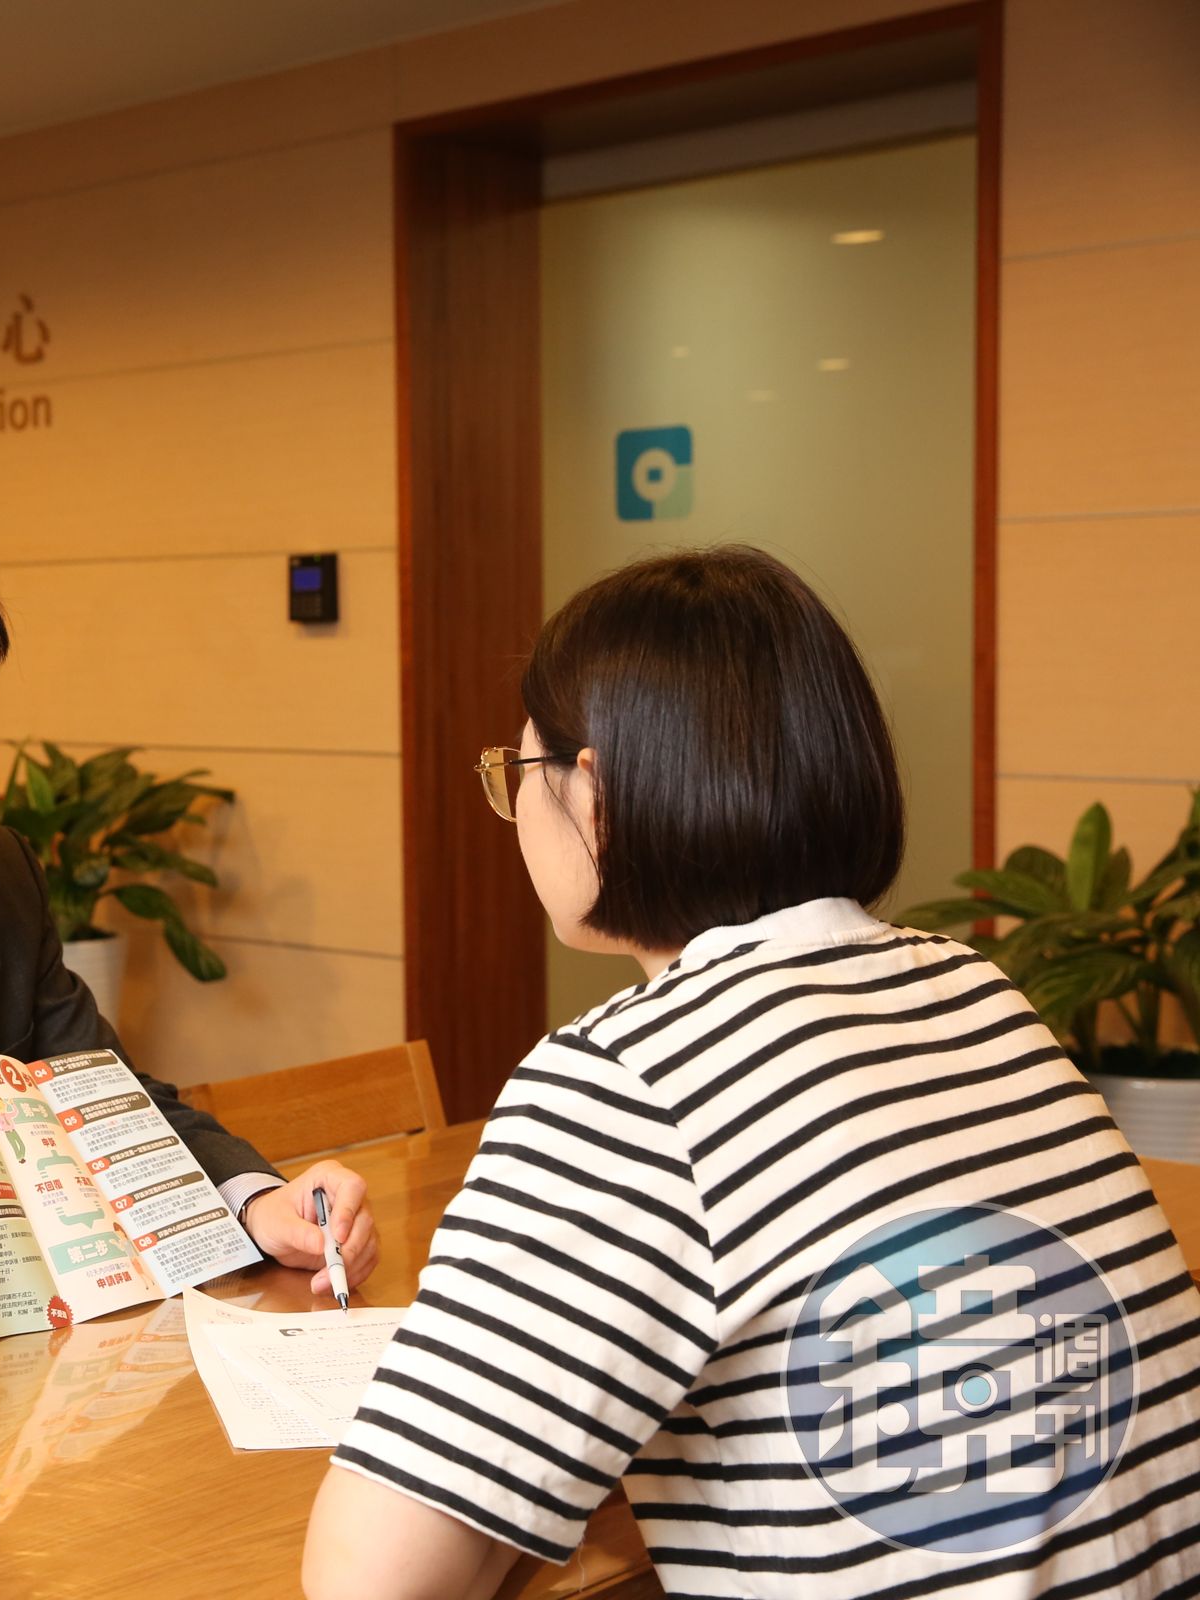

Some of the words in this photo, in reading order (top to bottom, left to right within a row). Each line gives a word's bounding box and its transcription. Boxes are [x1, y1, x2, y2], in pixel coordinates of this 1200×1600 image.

[20, 1102, 49, 1118] 第一步
[64, 1116, 78, 1126] Q5
[91, 1160, 105, 1171] Q6
[115, 1198, 128, 1210] Q7
[138, 1236, 152, 1248] Q8
[67, 1239, 109, 1264] 第二步
[96, 1271, 133, 1289] 申請評議
